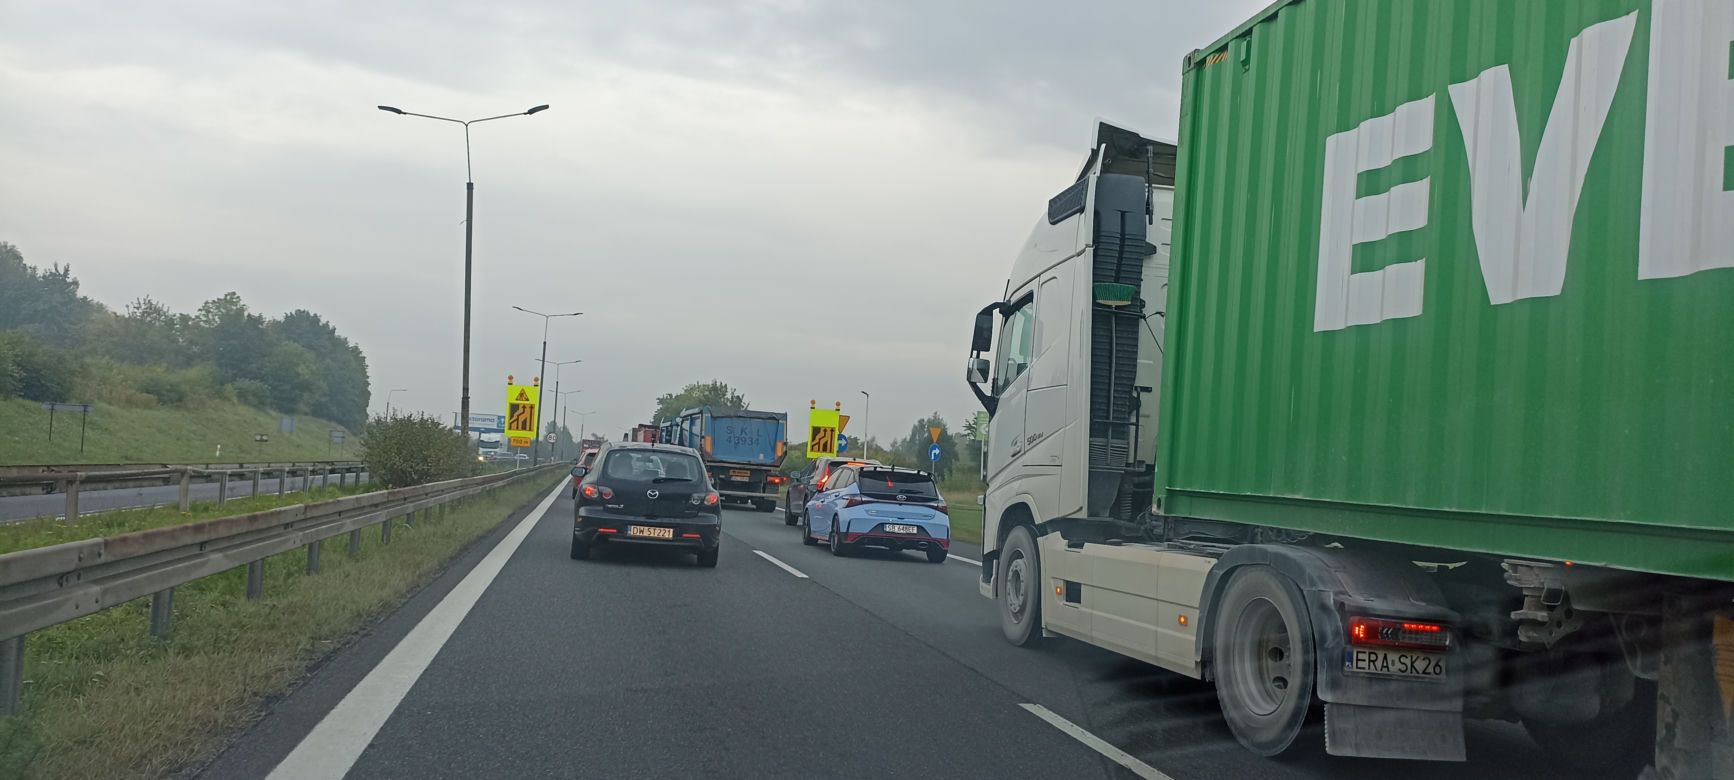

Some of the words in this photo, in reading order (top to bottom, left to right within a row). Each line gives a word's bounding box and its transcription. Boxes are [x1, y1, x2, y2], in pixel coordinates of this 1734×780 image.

[632, 526, 645, 536] DW
[648, 527, 671, 538] ST221
[1355, 650, 1390, 672] ERA
[1398, 654, 1442, 676] SK26
